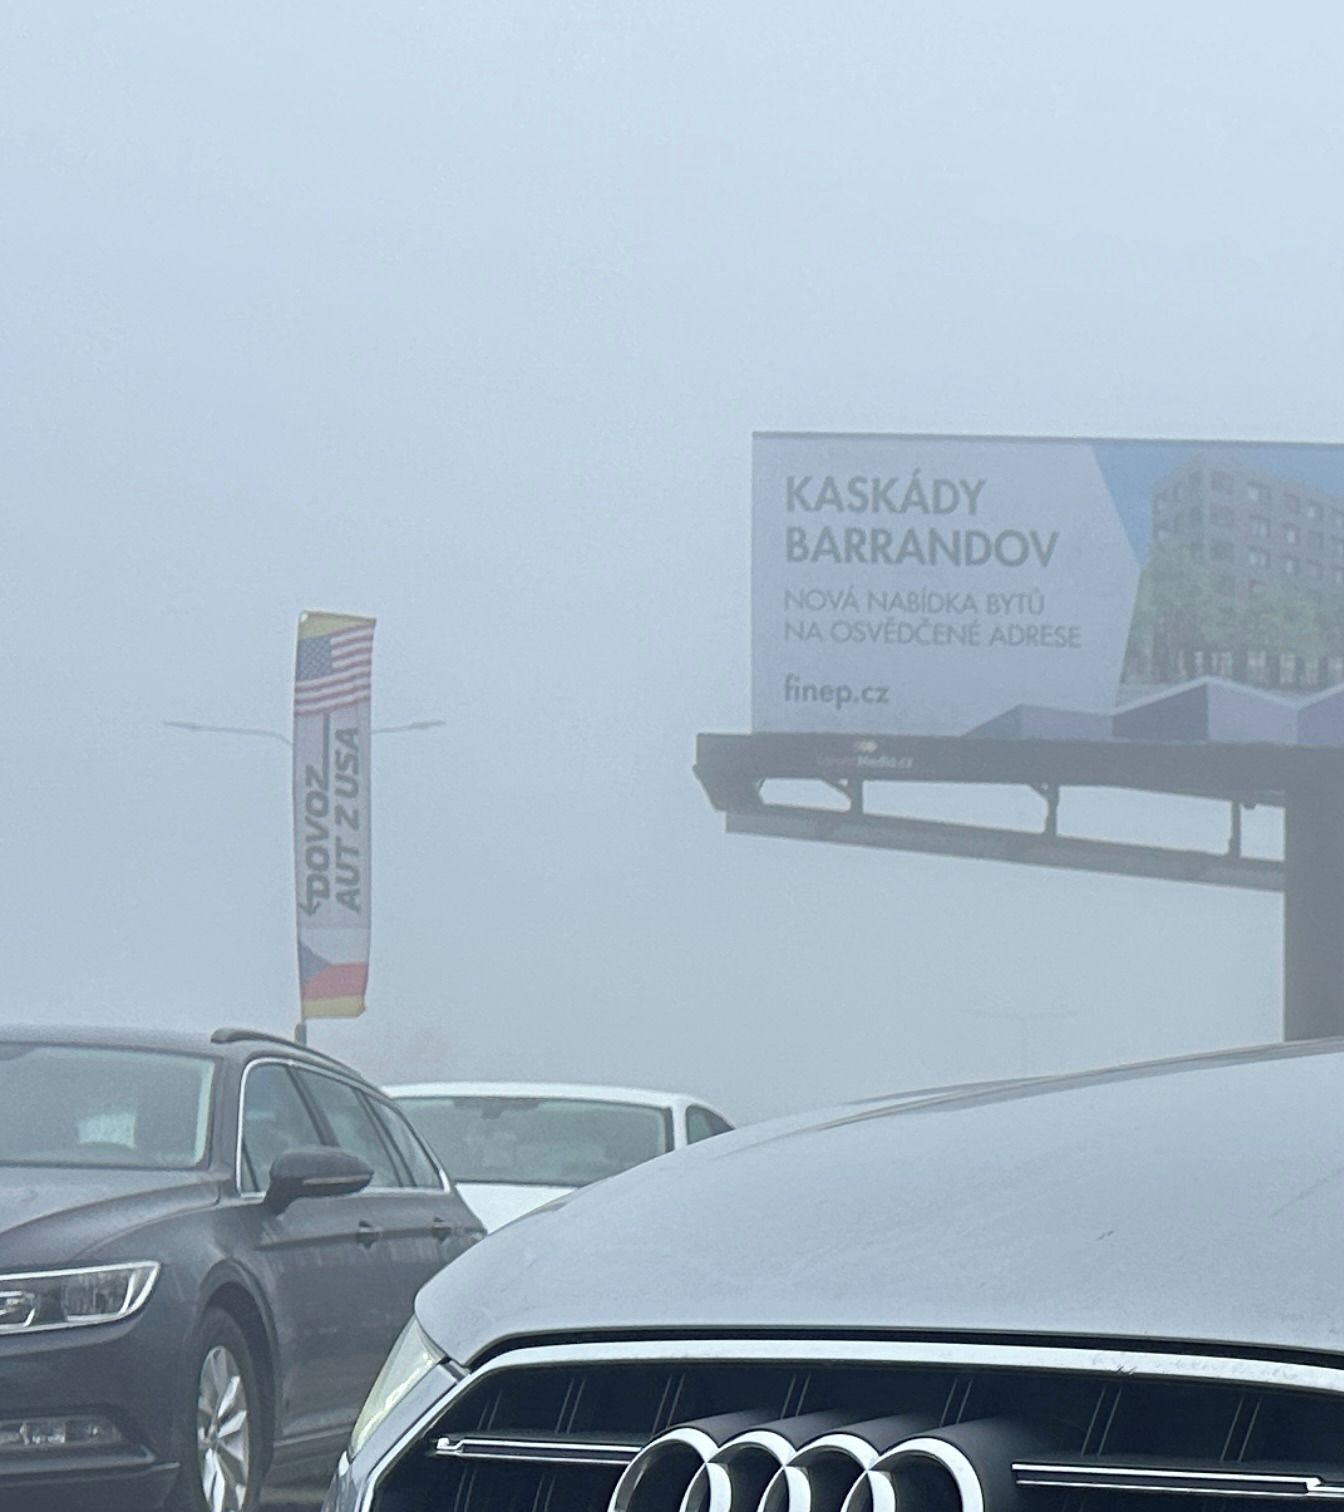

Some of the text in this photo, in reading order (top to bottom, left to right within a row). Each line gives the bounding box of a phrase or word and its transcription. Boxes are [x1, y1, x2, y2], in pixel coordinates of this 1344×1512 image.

[785, 467, 986, 516] KASKÁDY
[785, 526, 1060, 568] BARRANDOV
[784, 586, 1046, 616] NOVÁ NABÍDKA BYTŮ
[784, 615, 1082, 649] NA OSVĚDČENÉ ADRESE
[784, 673, 891, 711] finep.cz
[304, 755, 331, 902] DOVOZ
[334, 727, 362, 914] AUT Z USA
